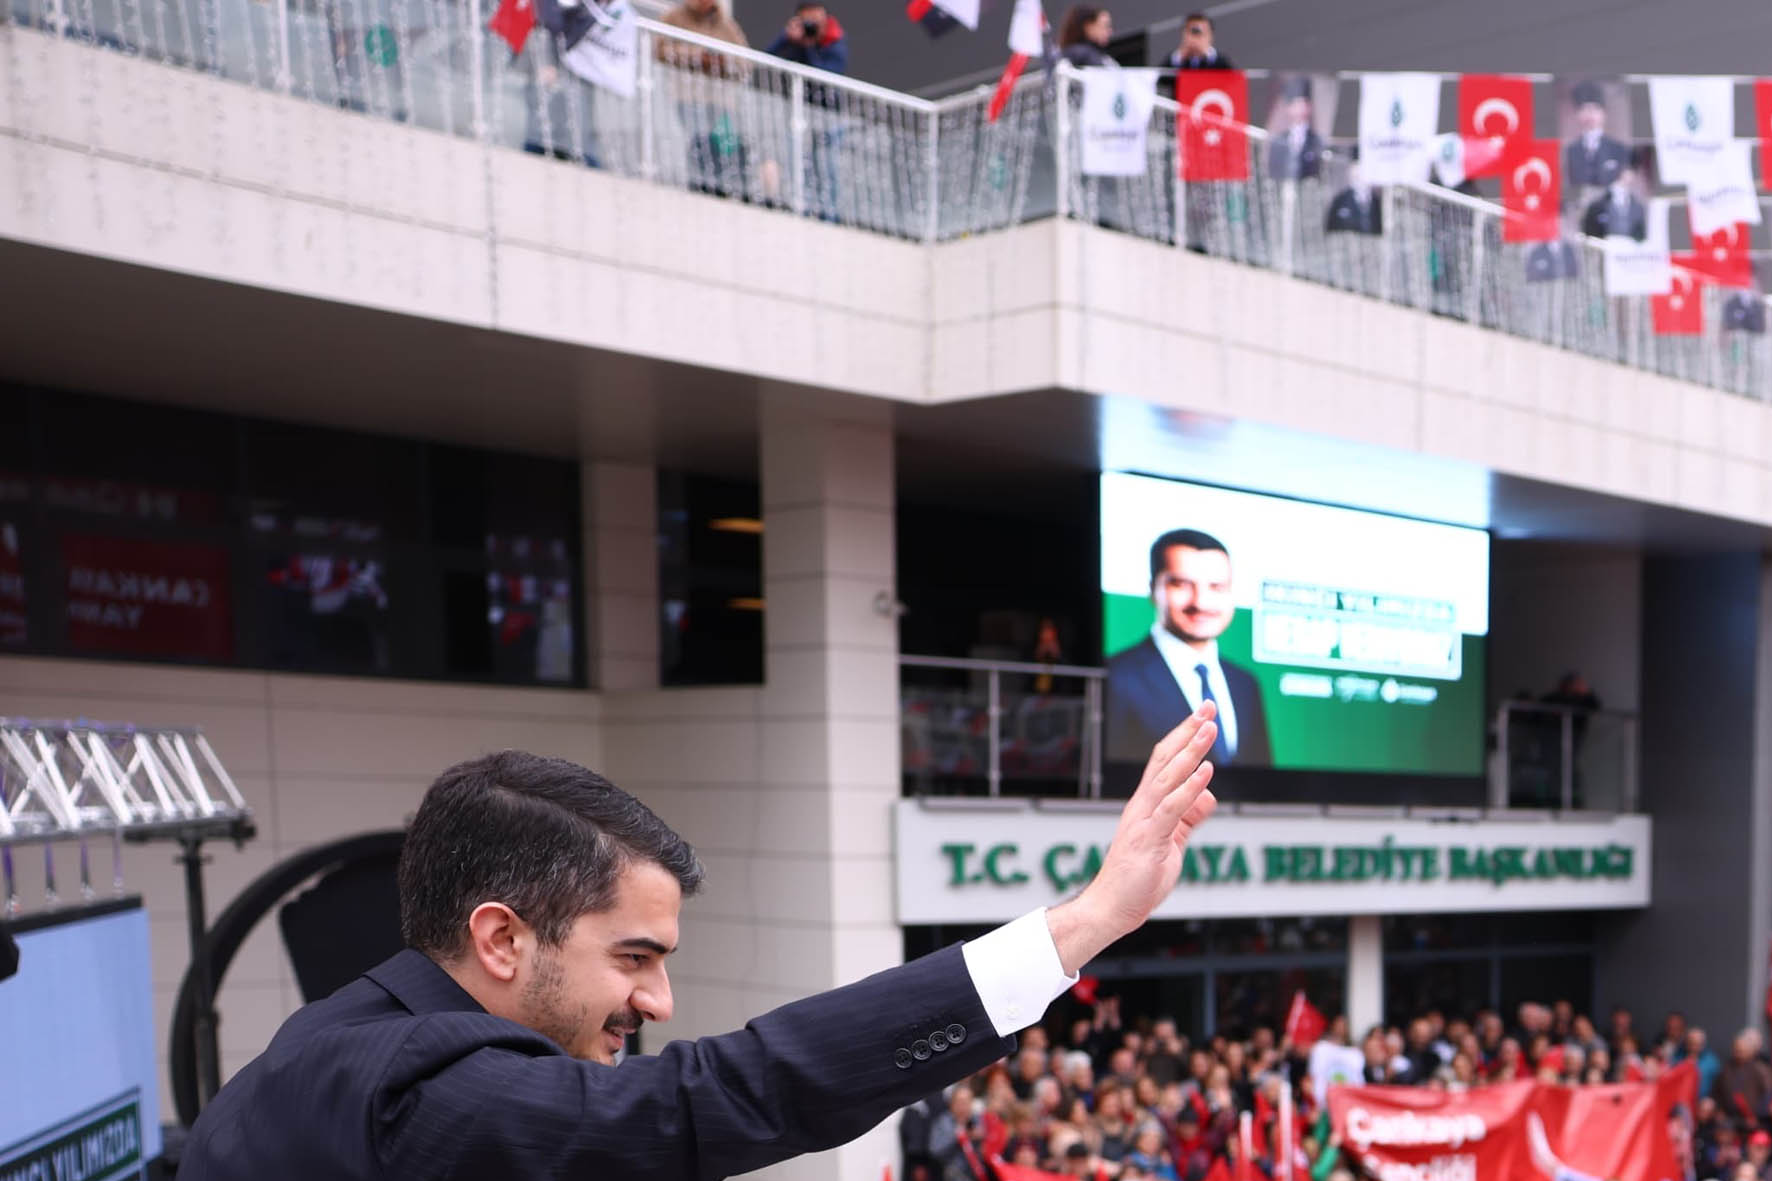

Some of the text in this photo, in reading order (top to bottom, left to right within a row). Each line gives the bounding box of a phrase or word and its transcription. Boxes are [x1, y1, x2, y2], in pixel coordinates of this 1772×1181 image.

[941, 834, 1635, 894] T.C. ÇAAYA BELEDİYE BAŞKANLIĞI
